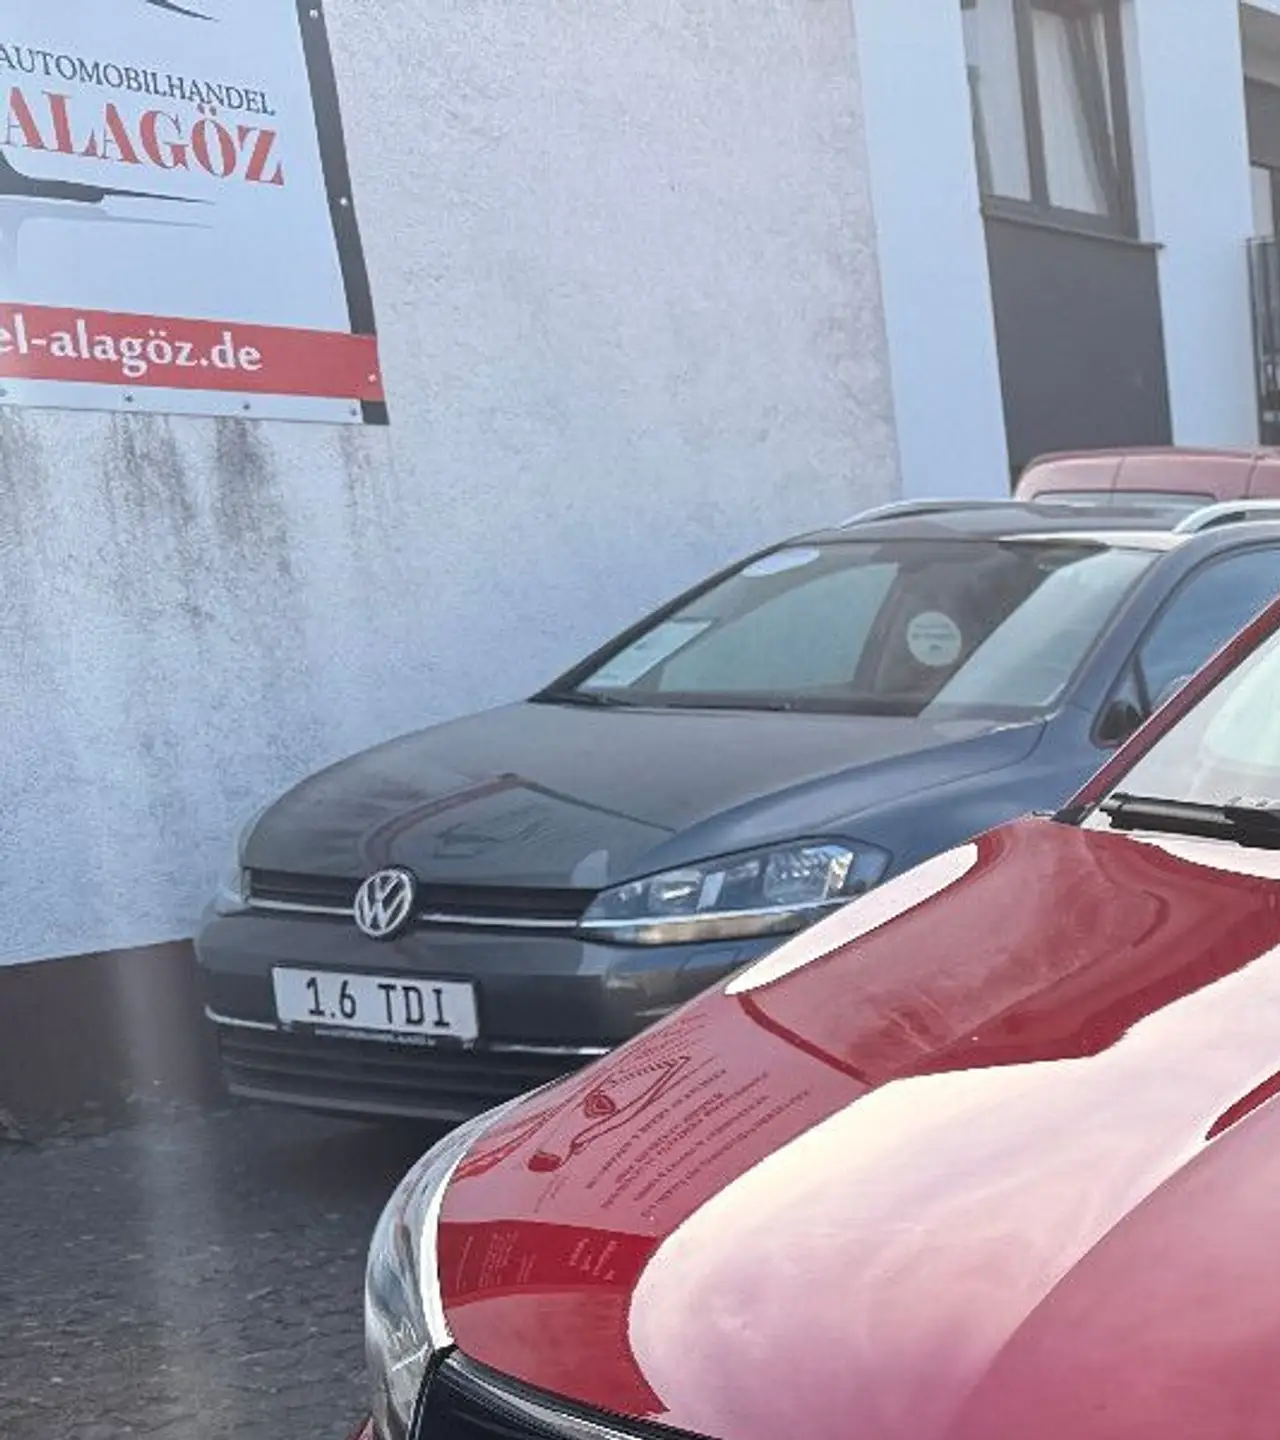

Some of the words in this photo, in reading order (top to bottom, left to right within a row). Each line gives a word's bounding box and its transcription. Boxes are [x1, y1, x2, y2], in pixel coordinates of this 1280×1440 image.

[1, 86, 285, 186] ALAGÖZ
[306, 976, 357, 1019] 1.6
[377, 982, 451, 1028] TDI
